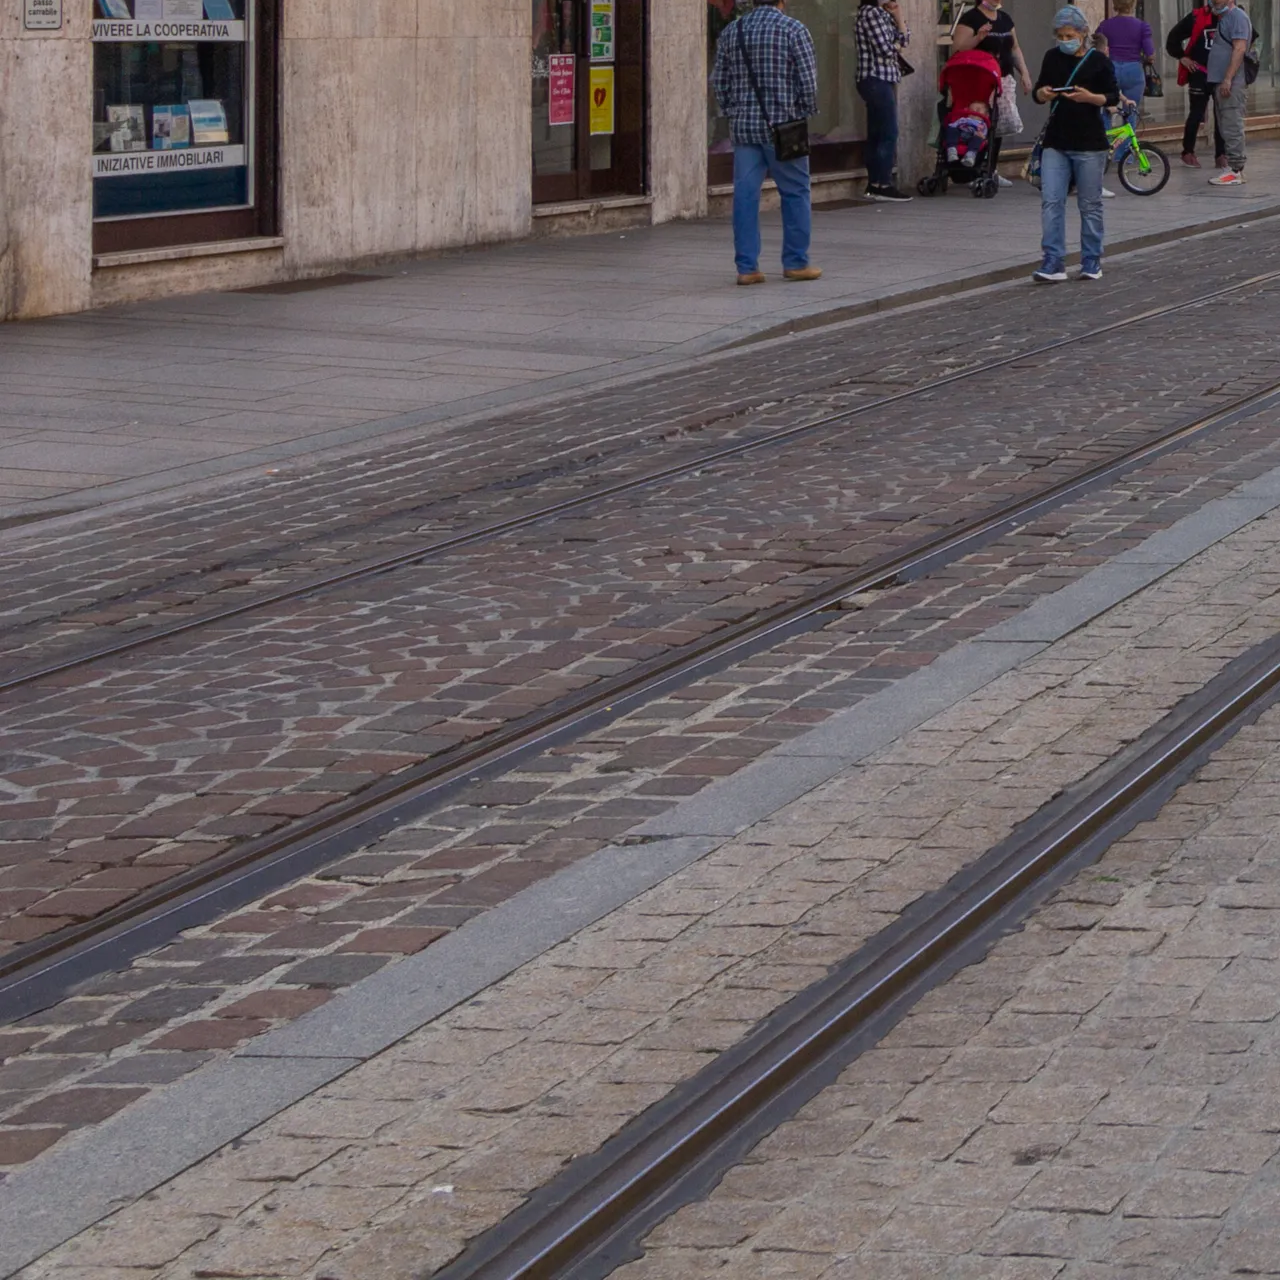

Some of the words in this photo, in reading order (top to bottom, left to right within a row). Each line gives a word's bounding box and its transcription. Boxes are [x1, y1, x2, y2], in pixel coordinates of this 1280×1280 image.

[33, 0, 53, 7] passo
[28, 8, 58, 16] carrabile
[93, 23, 134, 37] VIVERE
[136, 23, 151, 37] LA
[154, 24, 230, 37] COOPERATIVA
[97, 156, 154, 172] INIZIATIVE
[156, 150, 224, 168] IMMOBILIARI
